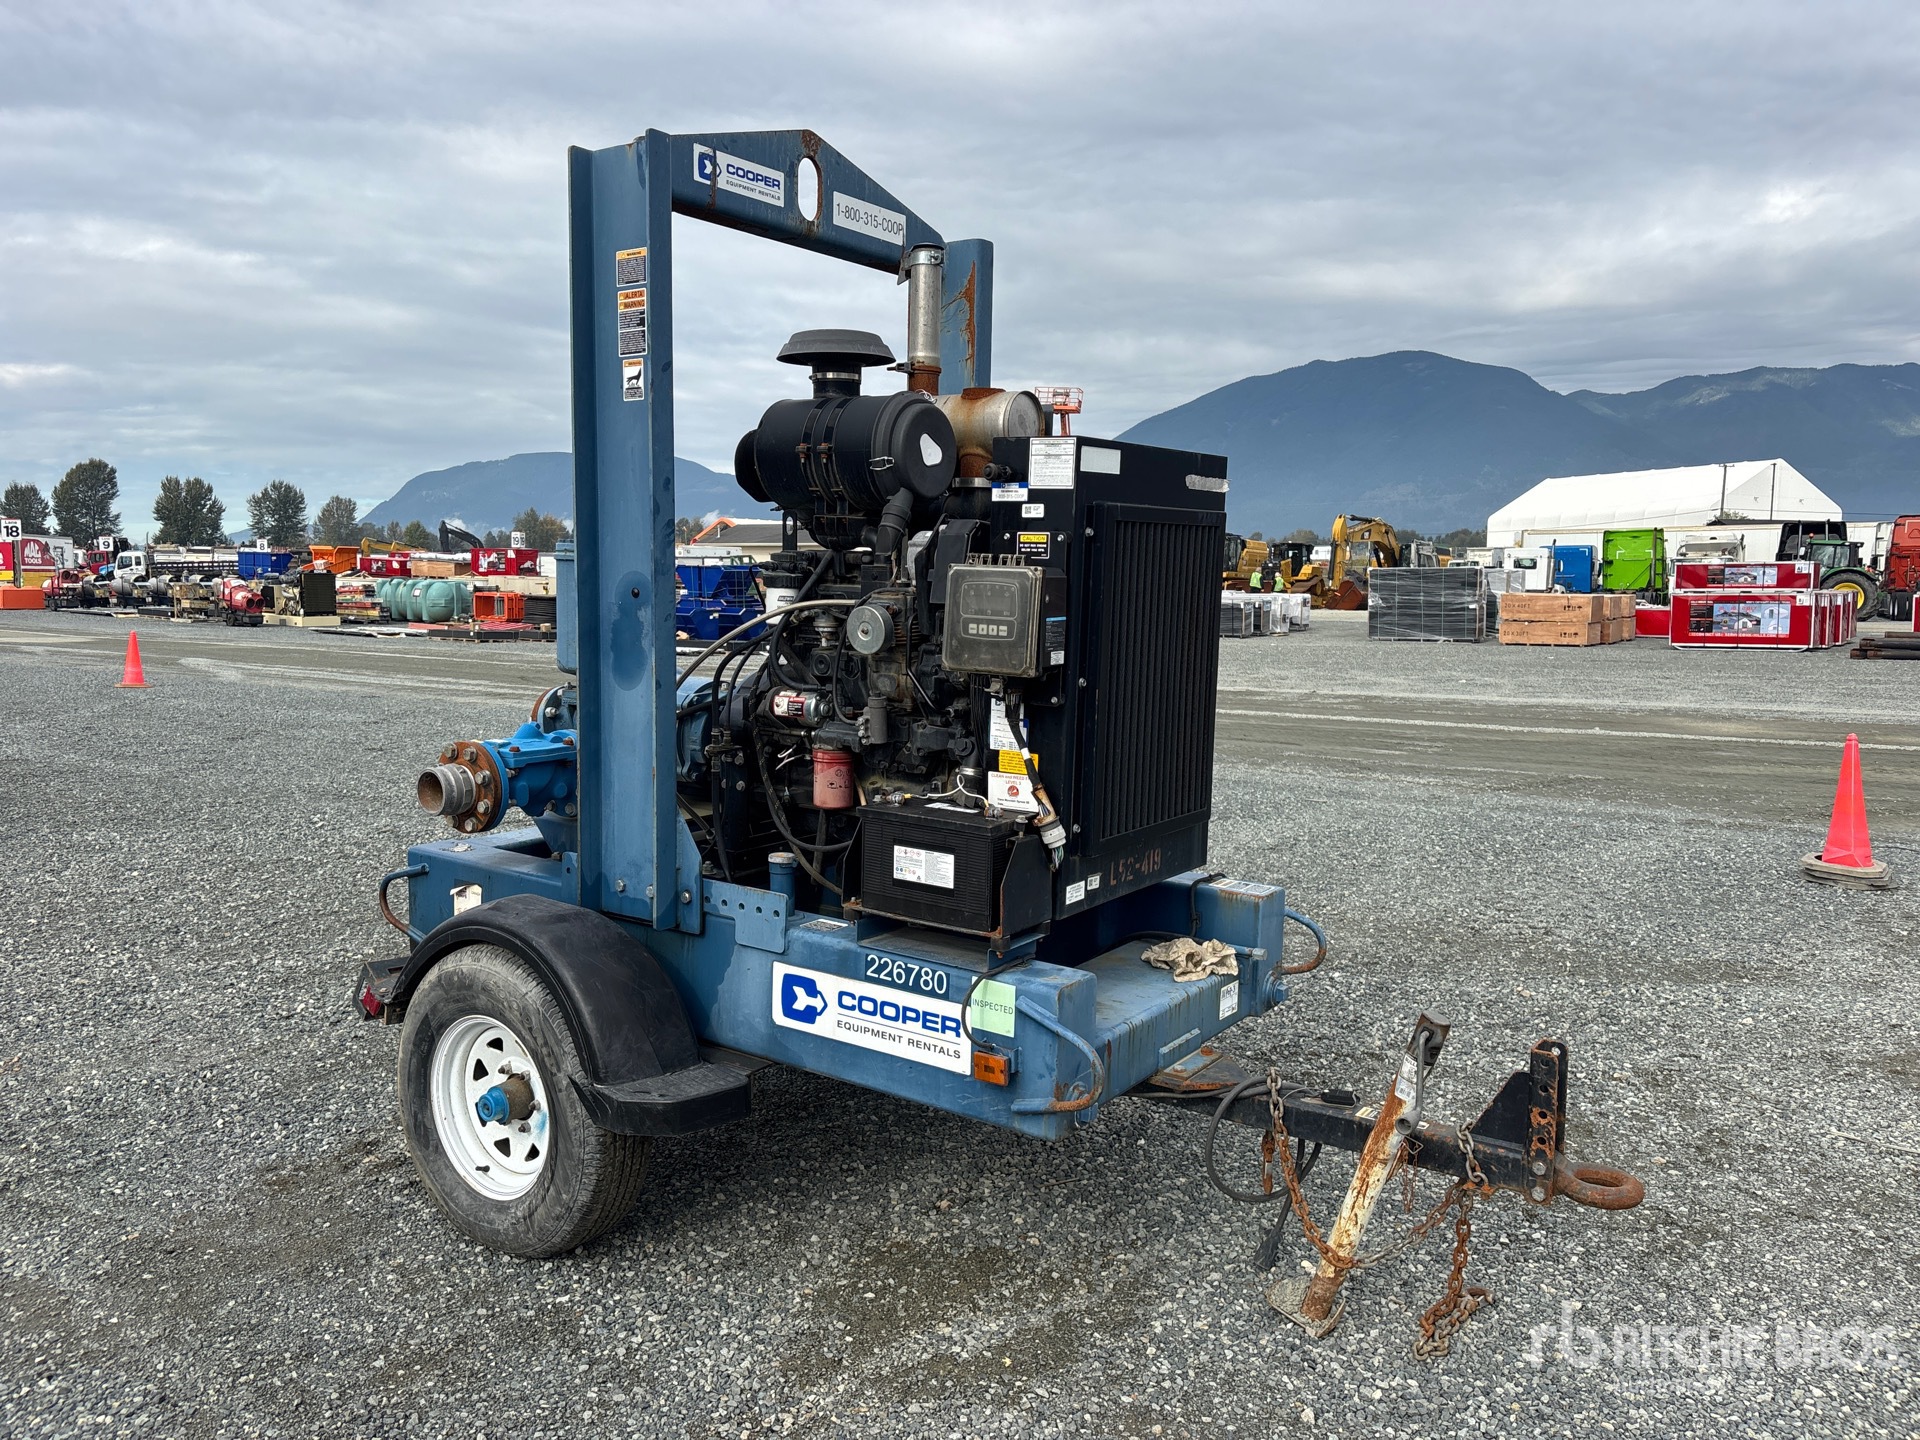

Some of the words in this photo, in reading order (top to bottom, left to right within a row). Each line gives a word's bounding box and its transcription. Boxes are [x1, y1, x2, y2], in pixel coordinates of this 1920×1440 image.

[726, 163, 781, 191] COOPER
[726, 180, 757, 194] EQUIPMENT
[758, 190, 781, 201] RENTALS
[836, 202, 904, 236] 1-800-315-COOP
[3, 525, 20, 537] 18
[24, 541, 42, 557] MAC
[103, 540, 110, 549] 9
[866, 954, 947, 994] 226780
[837, 990, 962, 1038] COOPER
[972, 997, 1014, 1015] INSPECTED
[836, 1019, 903, 1044] EQUIPMENT
[907, 1038, 961, 1060] RENTALS
